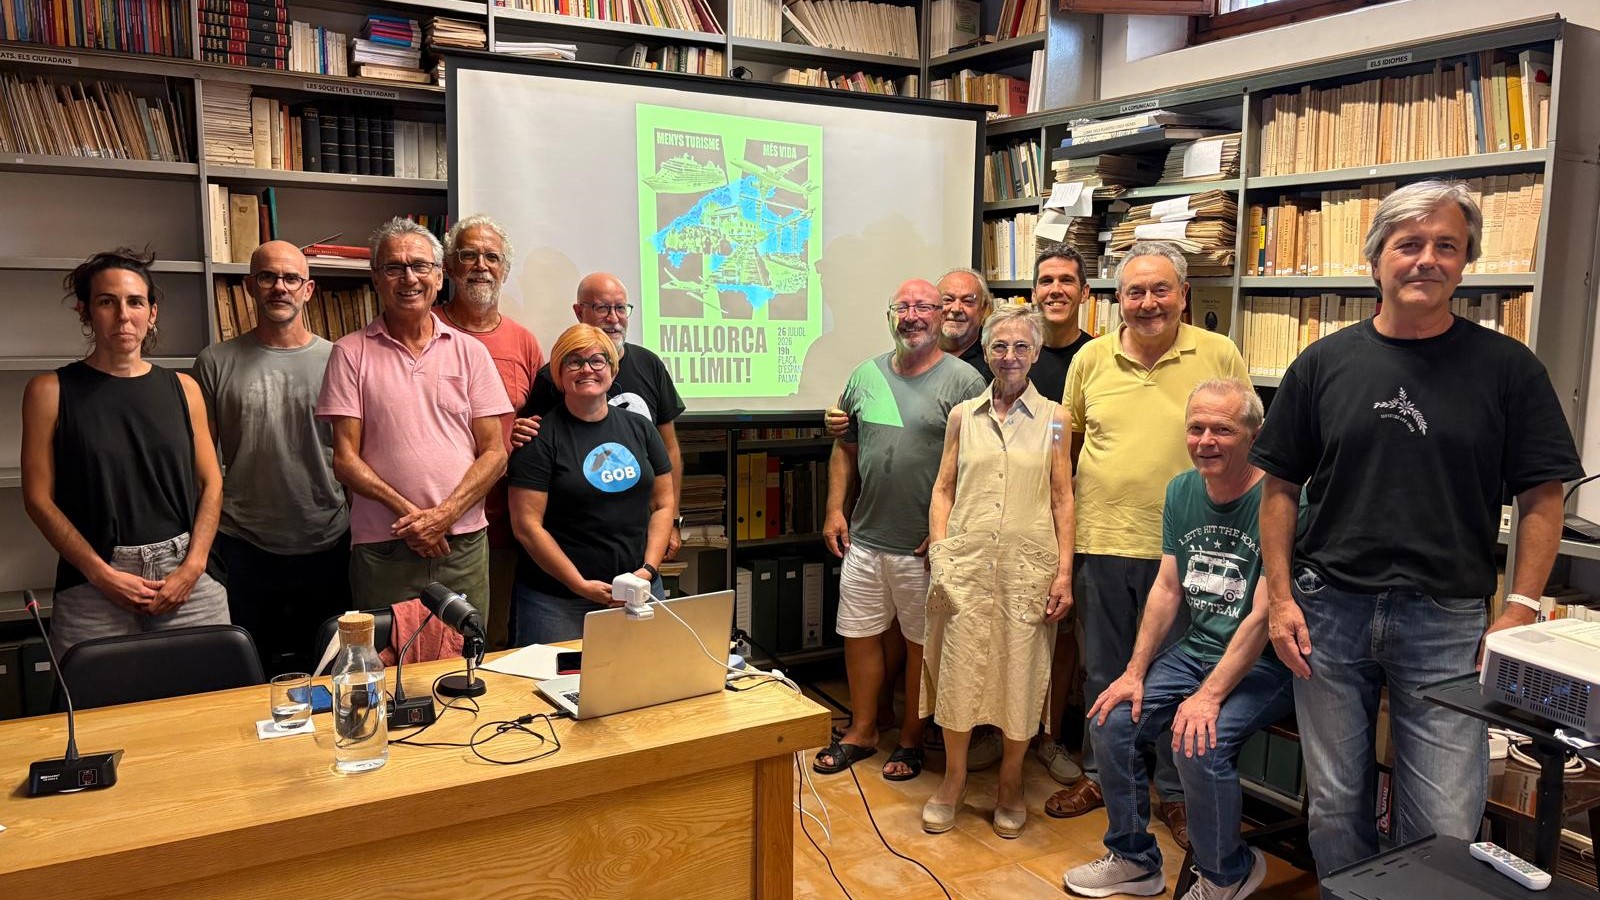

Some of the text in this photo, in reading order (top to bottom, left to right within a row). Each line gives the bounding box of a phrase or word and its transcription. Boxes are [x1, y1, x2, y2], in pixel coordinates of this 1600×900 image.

[32, 55, 72, 64] CIUTADANS
[1370, 55, 1408, 68] ELS IDIOMES
[352, 87, 362, 95] ELS
[363, 90, 395, 98] CIUTADANS
[656, 131, 720, 151] MENYS TURISME
[779, 145, 797, 160] VIDA
[659, 324, 768, 354] MALLORCA
[777, 327, 806, 337] 26 JULIOL
[778, 346, 790, 355] 19h
[689, 352, 752, 384] LÍMIT!
[777, 374, 798, 383] PALMA
[601, 466, 637, 483] GOB
[1178, 527, 1203, 546] LET'S
[1203, 525, 1218, 534] HIT
[1219, 526, 1240, 538] THE
[1208, 602, 1240, 618] TEAM
